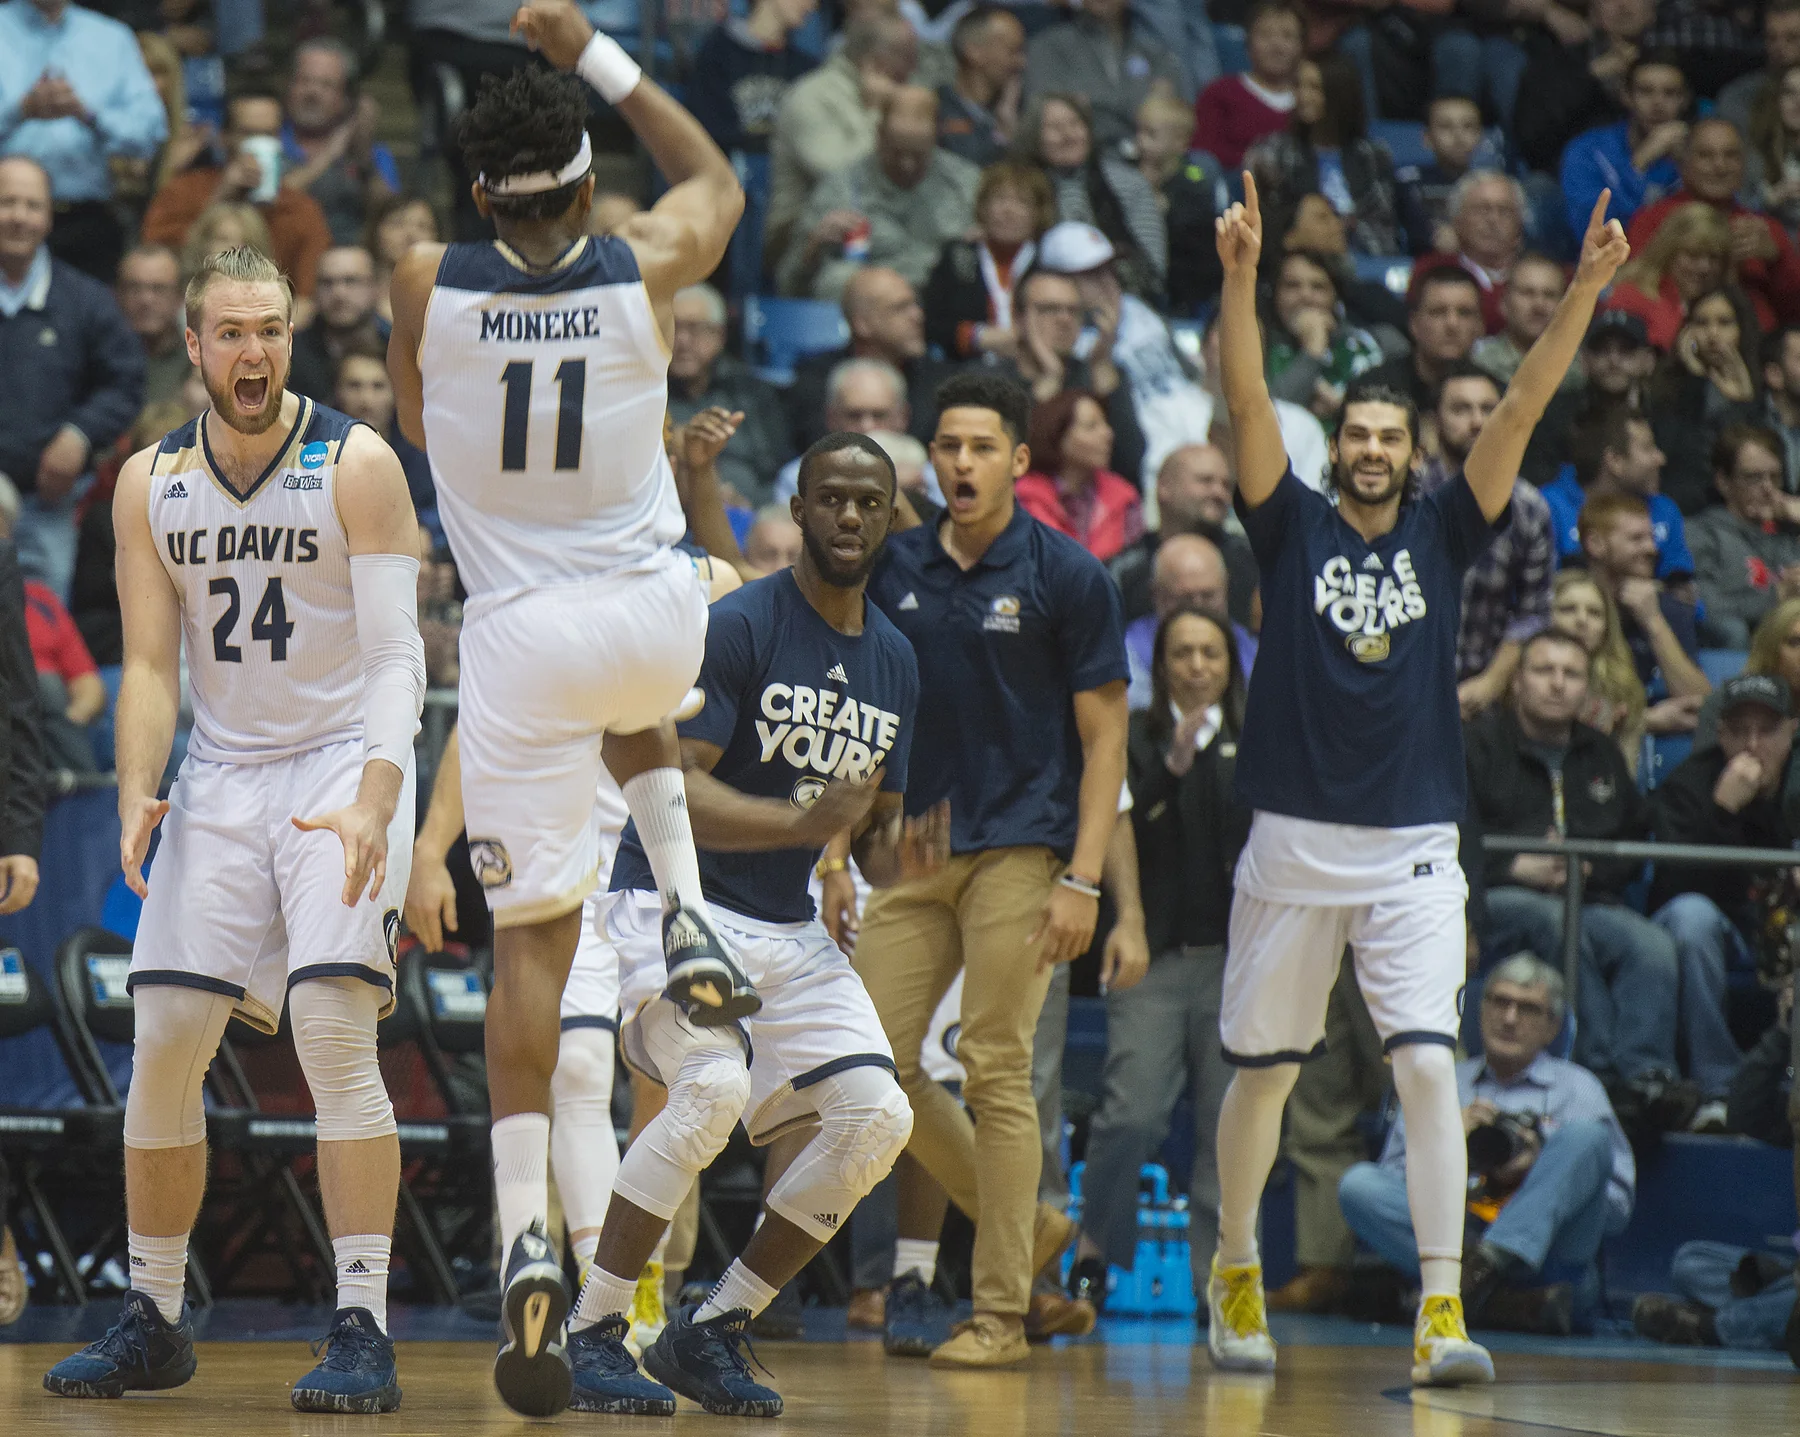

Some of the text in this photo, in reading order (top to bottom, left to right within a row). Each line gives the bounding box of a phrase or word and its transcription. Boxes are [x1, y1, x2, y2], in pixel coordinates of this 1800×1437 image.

[479, 306, 600, 342] MONEKE
[498, 356, 587, 472] 11
[167, 524, 319, 566] UC DAVIS
[207, 575, 296, 664] 24
[760, 682, 900, 751] CREATE
